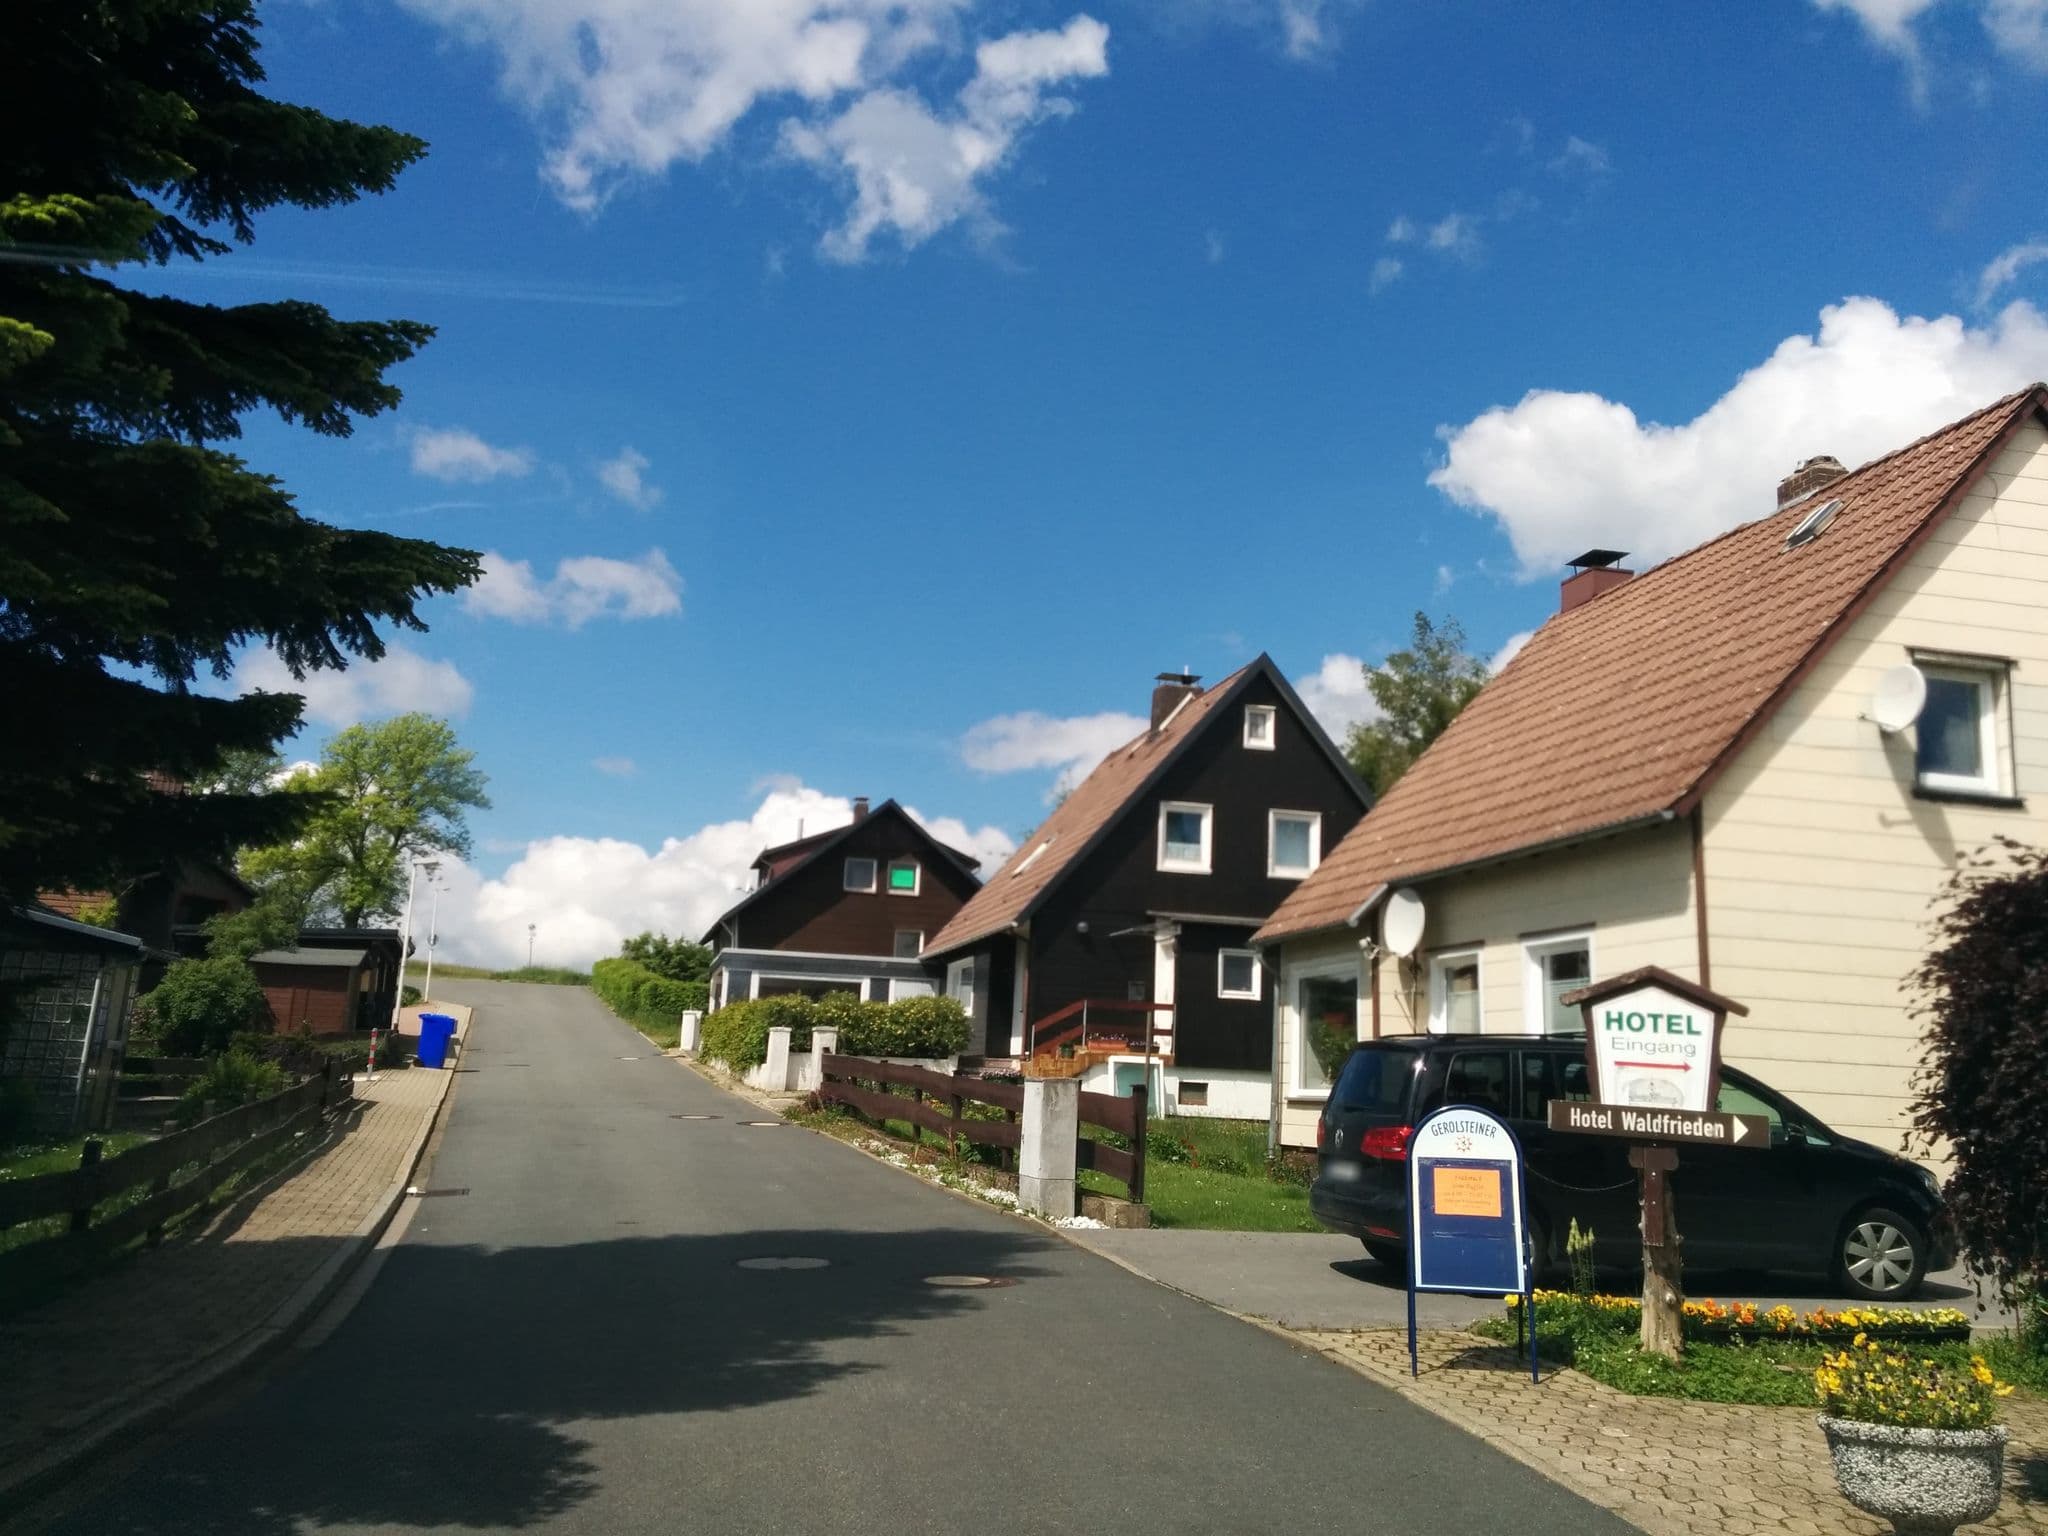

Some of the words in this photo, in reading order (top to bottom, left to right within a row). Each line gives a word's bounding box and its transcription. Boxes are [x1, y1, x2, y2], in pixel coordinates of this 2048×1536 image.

[1605, 1010, 1702, 1036] HOTEL
[1611, 1037, 1697, 1057] Eingang
[1431, 1120, 1498, 1139] GEROLSTEINER
[1570, 1107, 1613, 1130] Hotel
[1622, 1111, 1725, 1138] Waldfrieden
